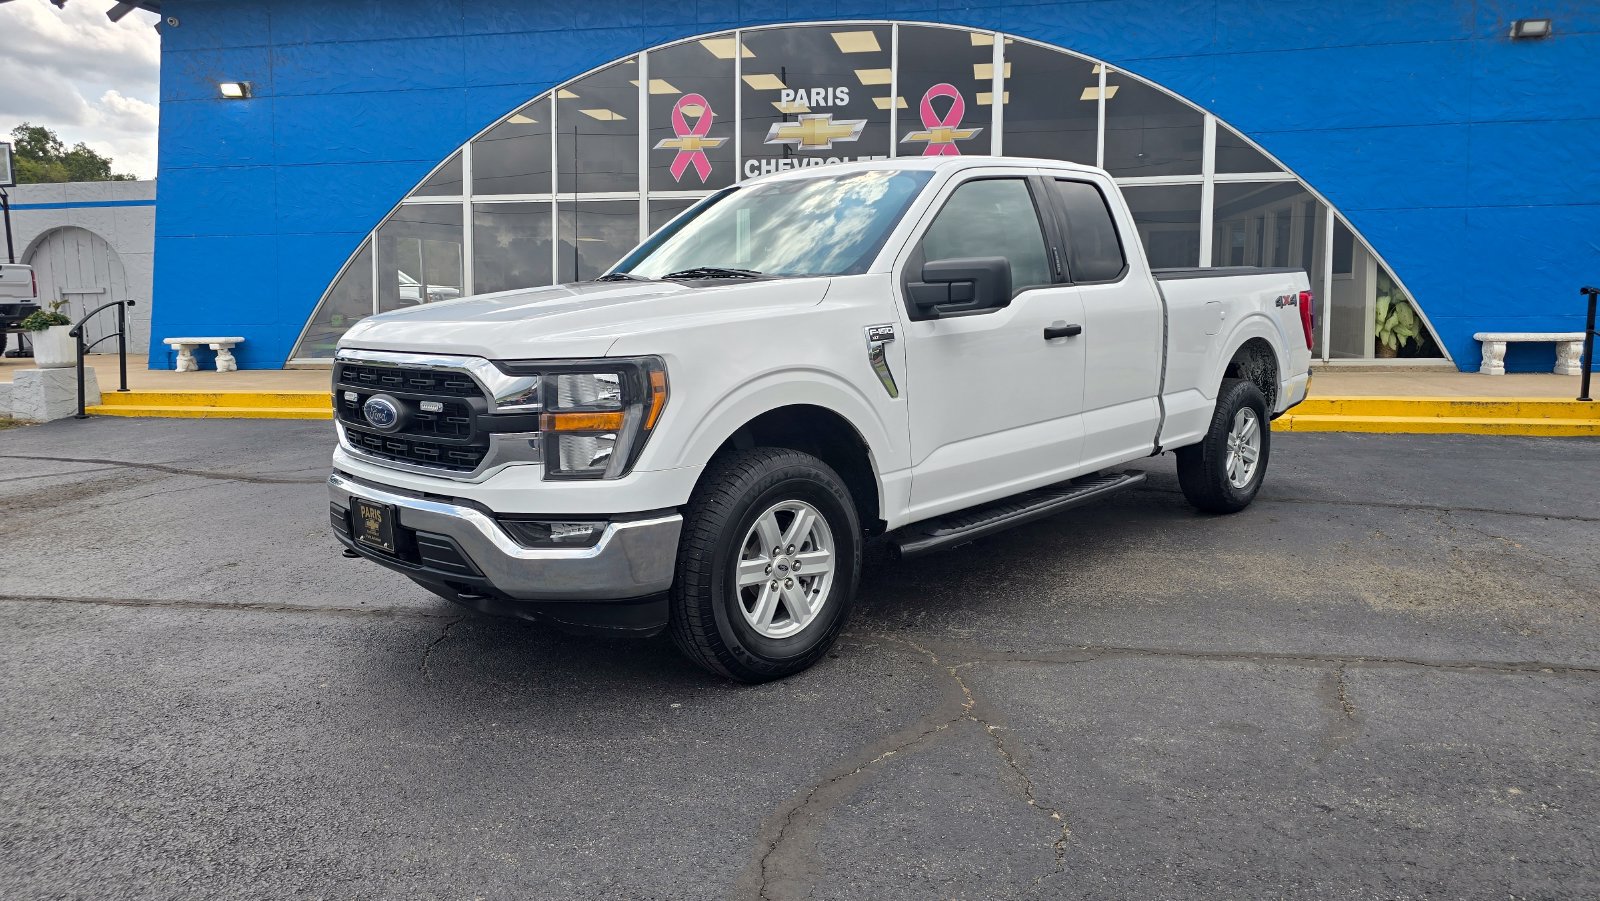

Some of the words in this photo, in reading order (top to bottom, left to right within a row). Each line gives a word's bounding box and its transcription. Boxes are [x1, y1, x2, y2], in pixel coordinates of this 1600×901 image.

[781, 87, 850, 107] PARIS
[744, 156, 887, 178] CHEVR
[360, 505, 382, 523] PARIS
